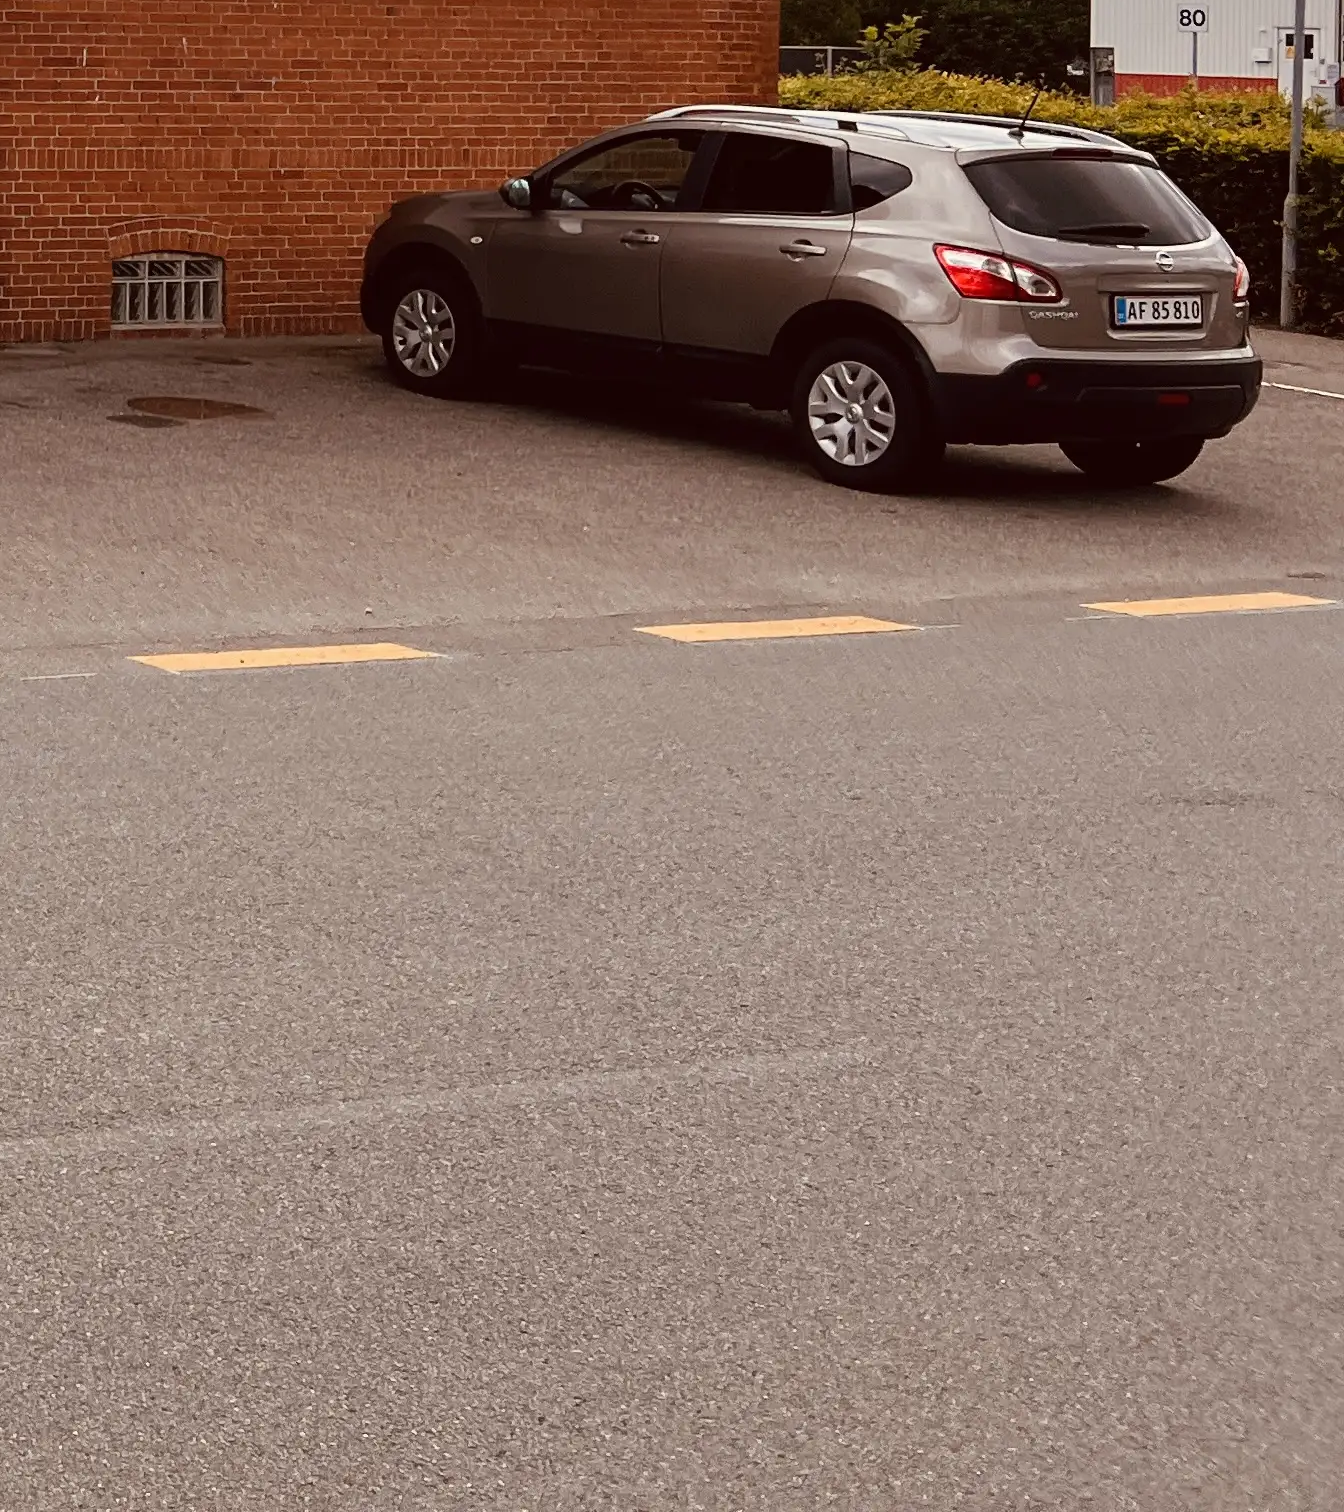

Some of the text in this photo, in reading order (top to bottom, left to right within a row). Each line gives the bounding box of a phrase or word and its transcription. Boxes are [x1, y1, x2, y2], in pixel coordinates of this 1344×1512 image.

[1179, 9, 1205, 26] 80
[1127, 300, 1200, 320] AF 85 810
